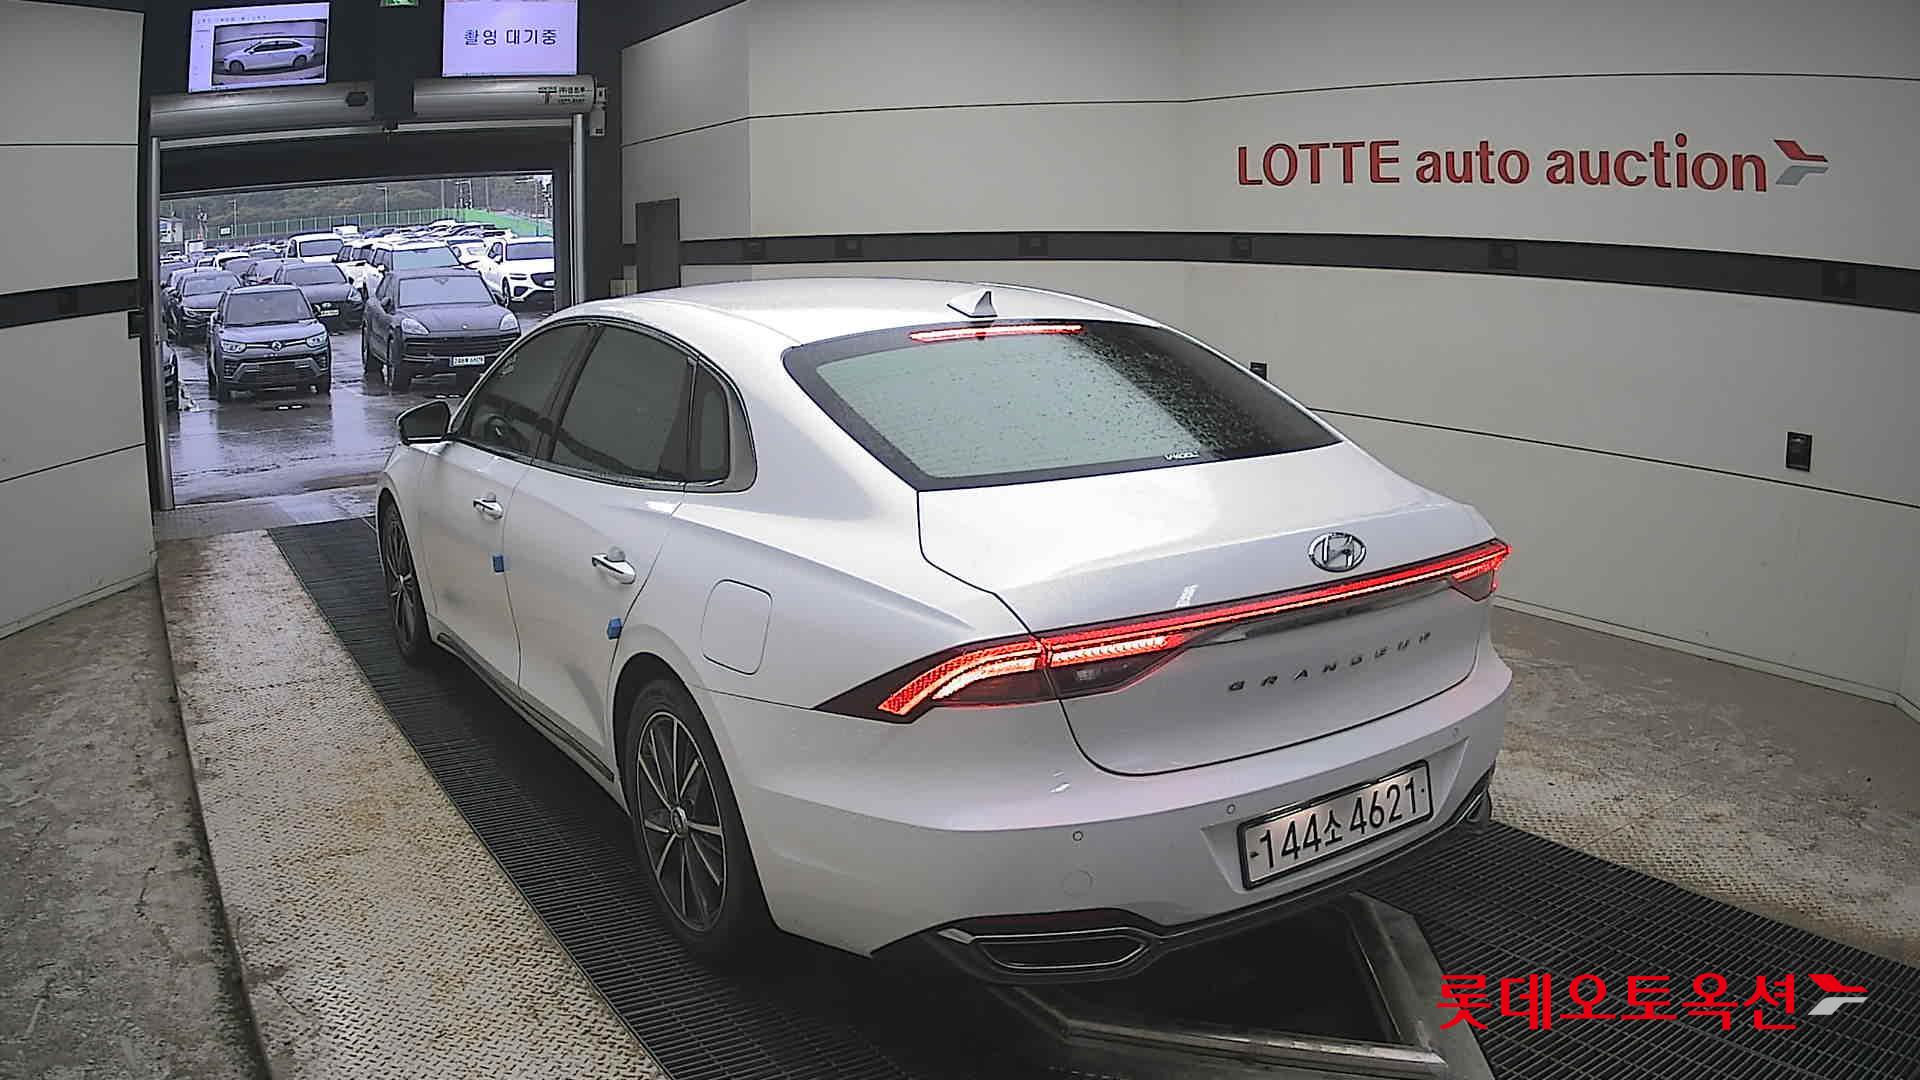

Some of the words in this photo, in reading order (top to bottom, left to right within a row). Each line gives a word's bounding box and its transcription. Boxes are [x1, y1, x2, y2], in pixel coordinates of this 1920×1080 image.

[506, 29, 556, 45] 대기중
[1237, 140, 1401, 187] LOTTE
[1415, 140, 1531, 185] auto
[1545, 133, 1768, 193] auction
[1228, 632, 1431, 691] GRANDEUR
